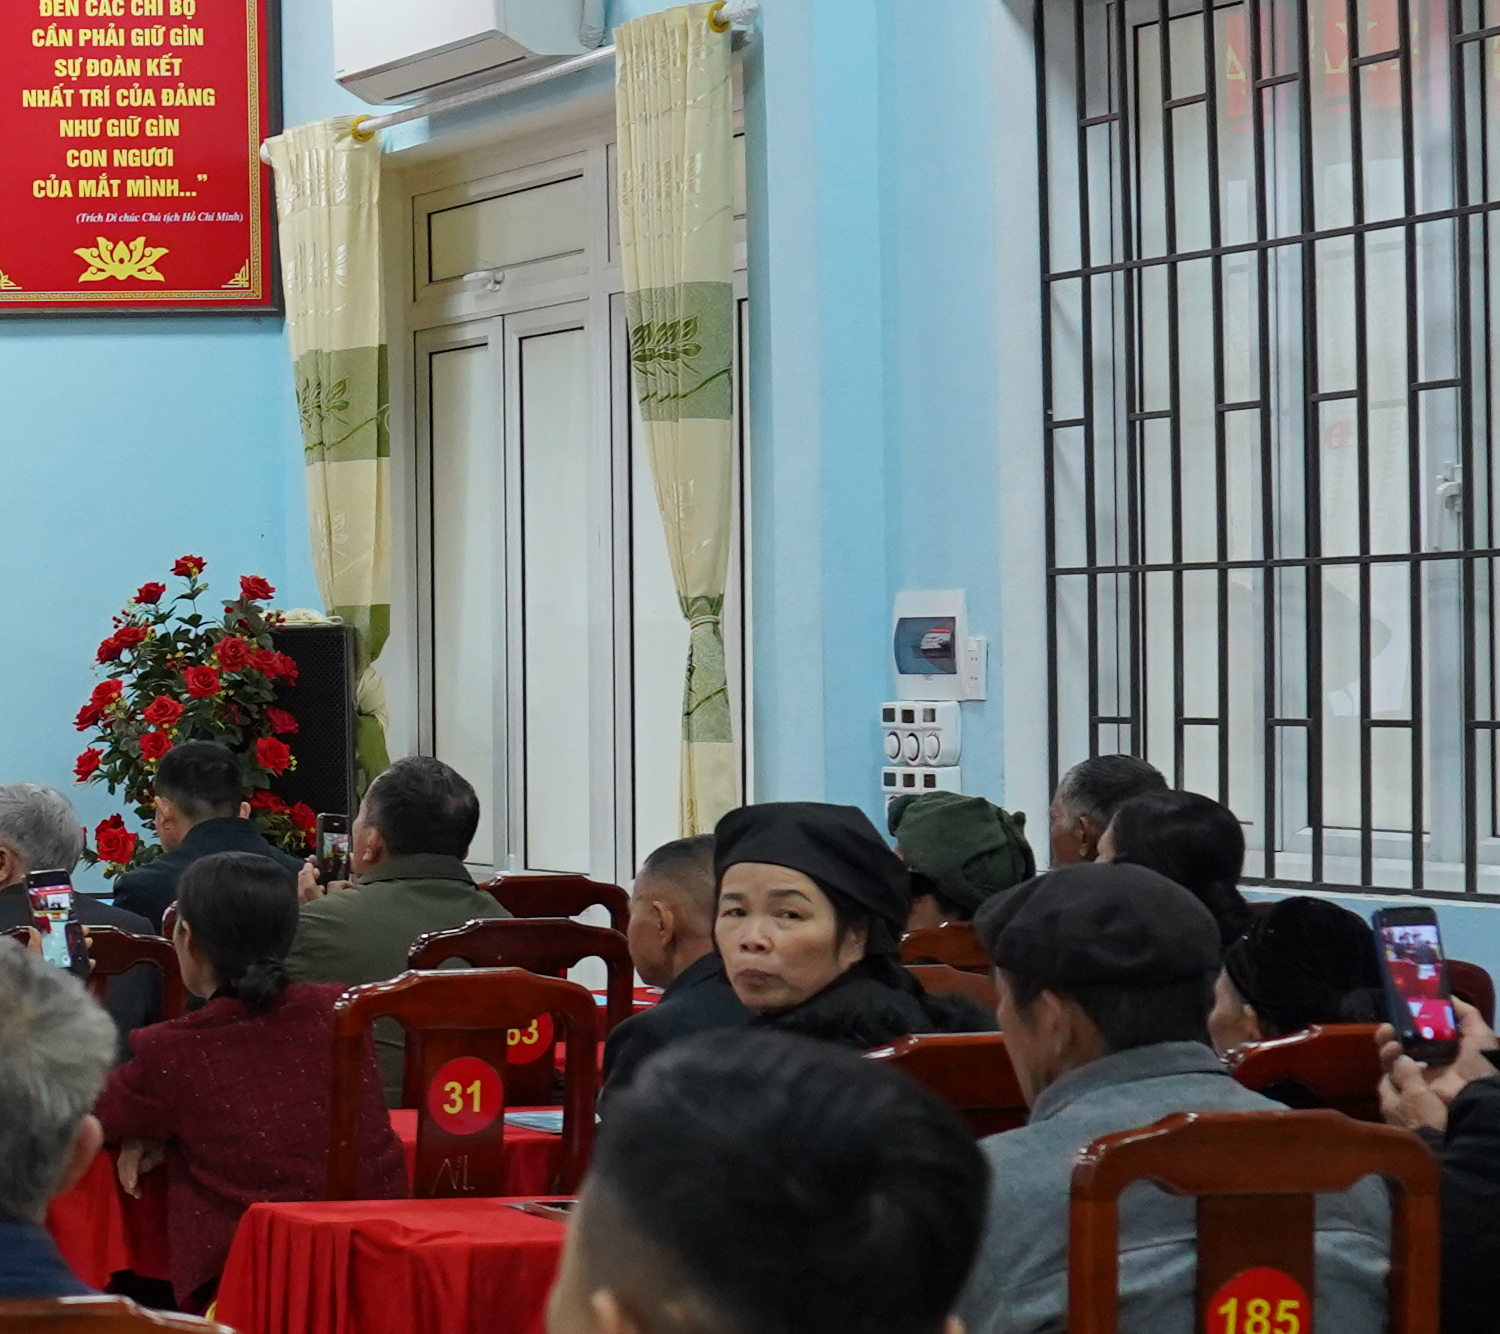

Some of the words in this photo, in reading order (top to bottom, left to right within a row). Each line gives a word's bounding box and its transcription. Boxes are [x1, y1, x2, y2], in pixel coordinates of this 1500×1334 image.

[32, 24, 73, 47] CẦN
[79, 24, 125, 46] PHẢI
[131, 25, 165, 46] GIỮ
[170, 25, 203, 46] GÌN
[55, 57, 83, 80] SỰ
[86, 55, 140, 76] ĐOÀN
[147, 54, 182, 76] KẾT
[23, 84, 74, 107] NHẤT
[79, 85, 110, 107] TRÍ
[116, 84, 156, 106] CỦA
[161, 84, 215, 106] ĐẢNG
[60, 118, 102, 137] NHƯ
[107, 116, 141, 137] GIỮ
[146, 115, 179, 136] GÌN
[67, 149, 107, 167] CON
[113, 147, 173, 167] NGƯƠI
[33, 175, 73, 198] CỦA
[79, 175, 121, 197] MẮT
[443, 1080, 483, 1114] 31
